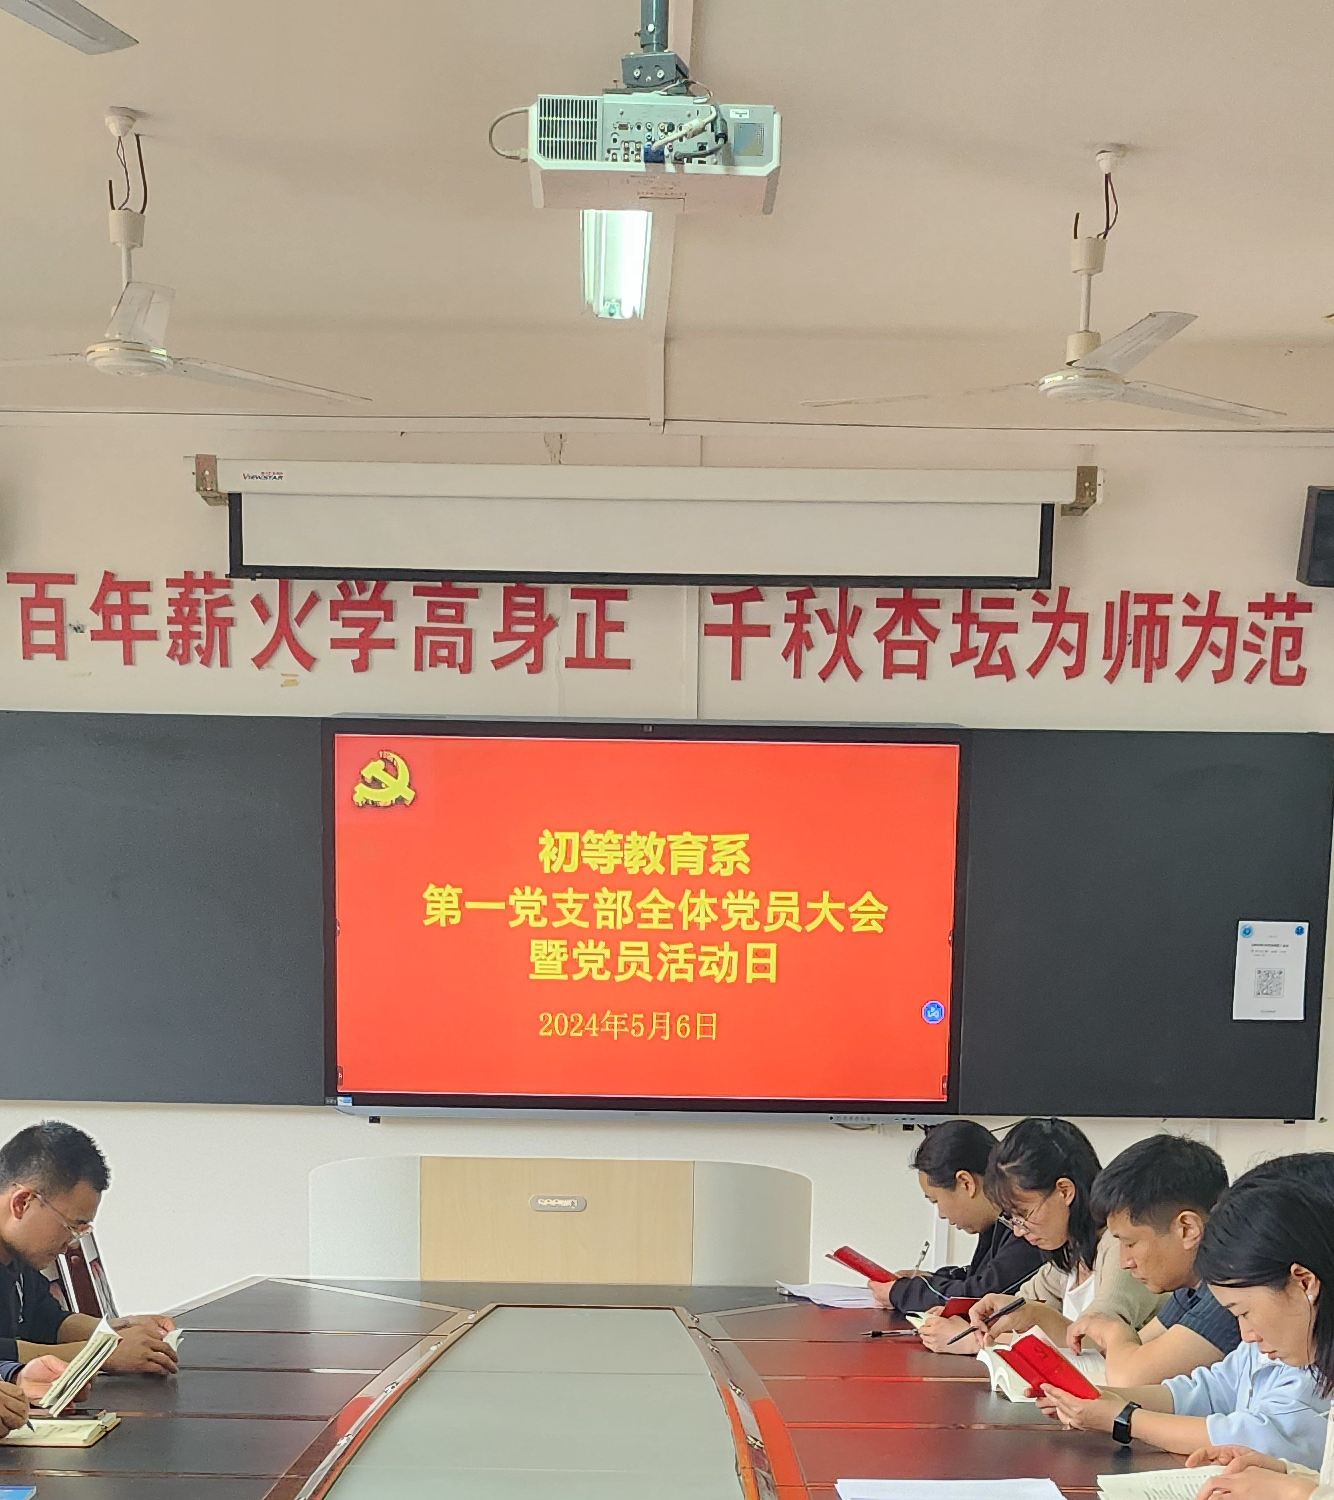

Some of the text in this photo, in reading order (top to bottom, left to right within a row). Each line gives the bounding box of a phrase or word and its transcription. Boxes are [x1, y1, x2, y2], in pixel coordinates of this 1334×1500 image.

[6, 570, 1313, 686] 百年薪火学高身正 千秋杏坛为师为范
[538, 828, 751, 877] 初等教育系
[422, 882, 889, 934] 第一党支部全体党员大会
[528, 939, 778, 984] 暨党员活动日
[538, 1009, 718, 1041] 2024年5月6日
